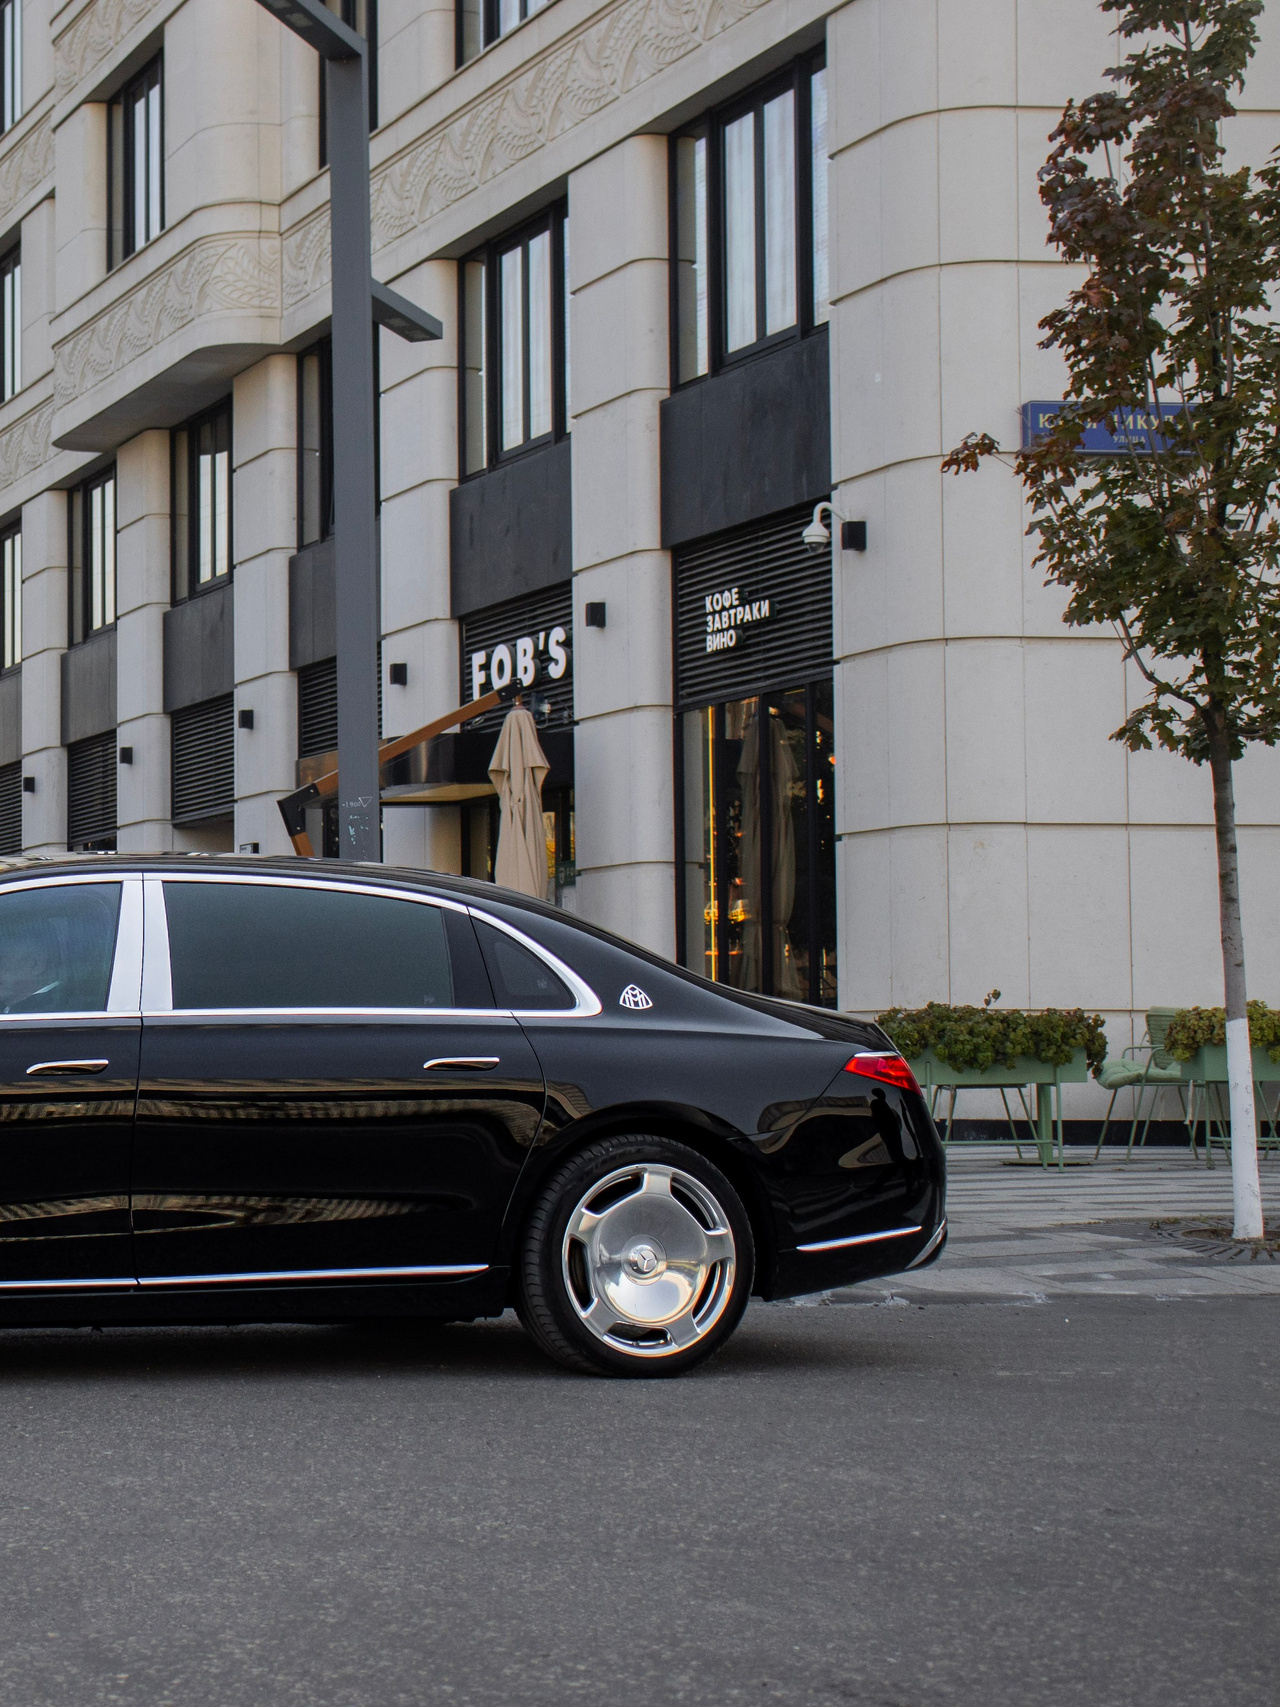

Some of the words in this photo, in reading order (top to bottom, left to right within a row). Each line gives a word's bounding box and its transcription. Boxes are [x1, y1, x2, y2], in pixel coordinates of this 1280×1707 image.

[705, 587, 740, 613] КОФЕ
[706, 599, 770, 633] ЗАВТРАКИ
[706, 629, 736, 653] ВИНО
[472, 626, 567, 701] FOB'S
